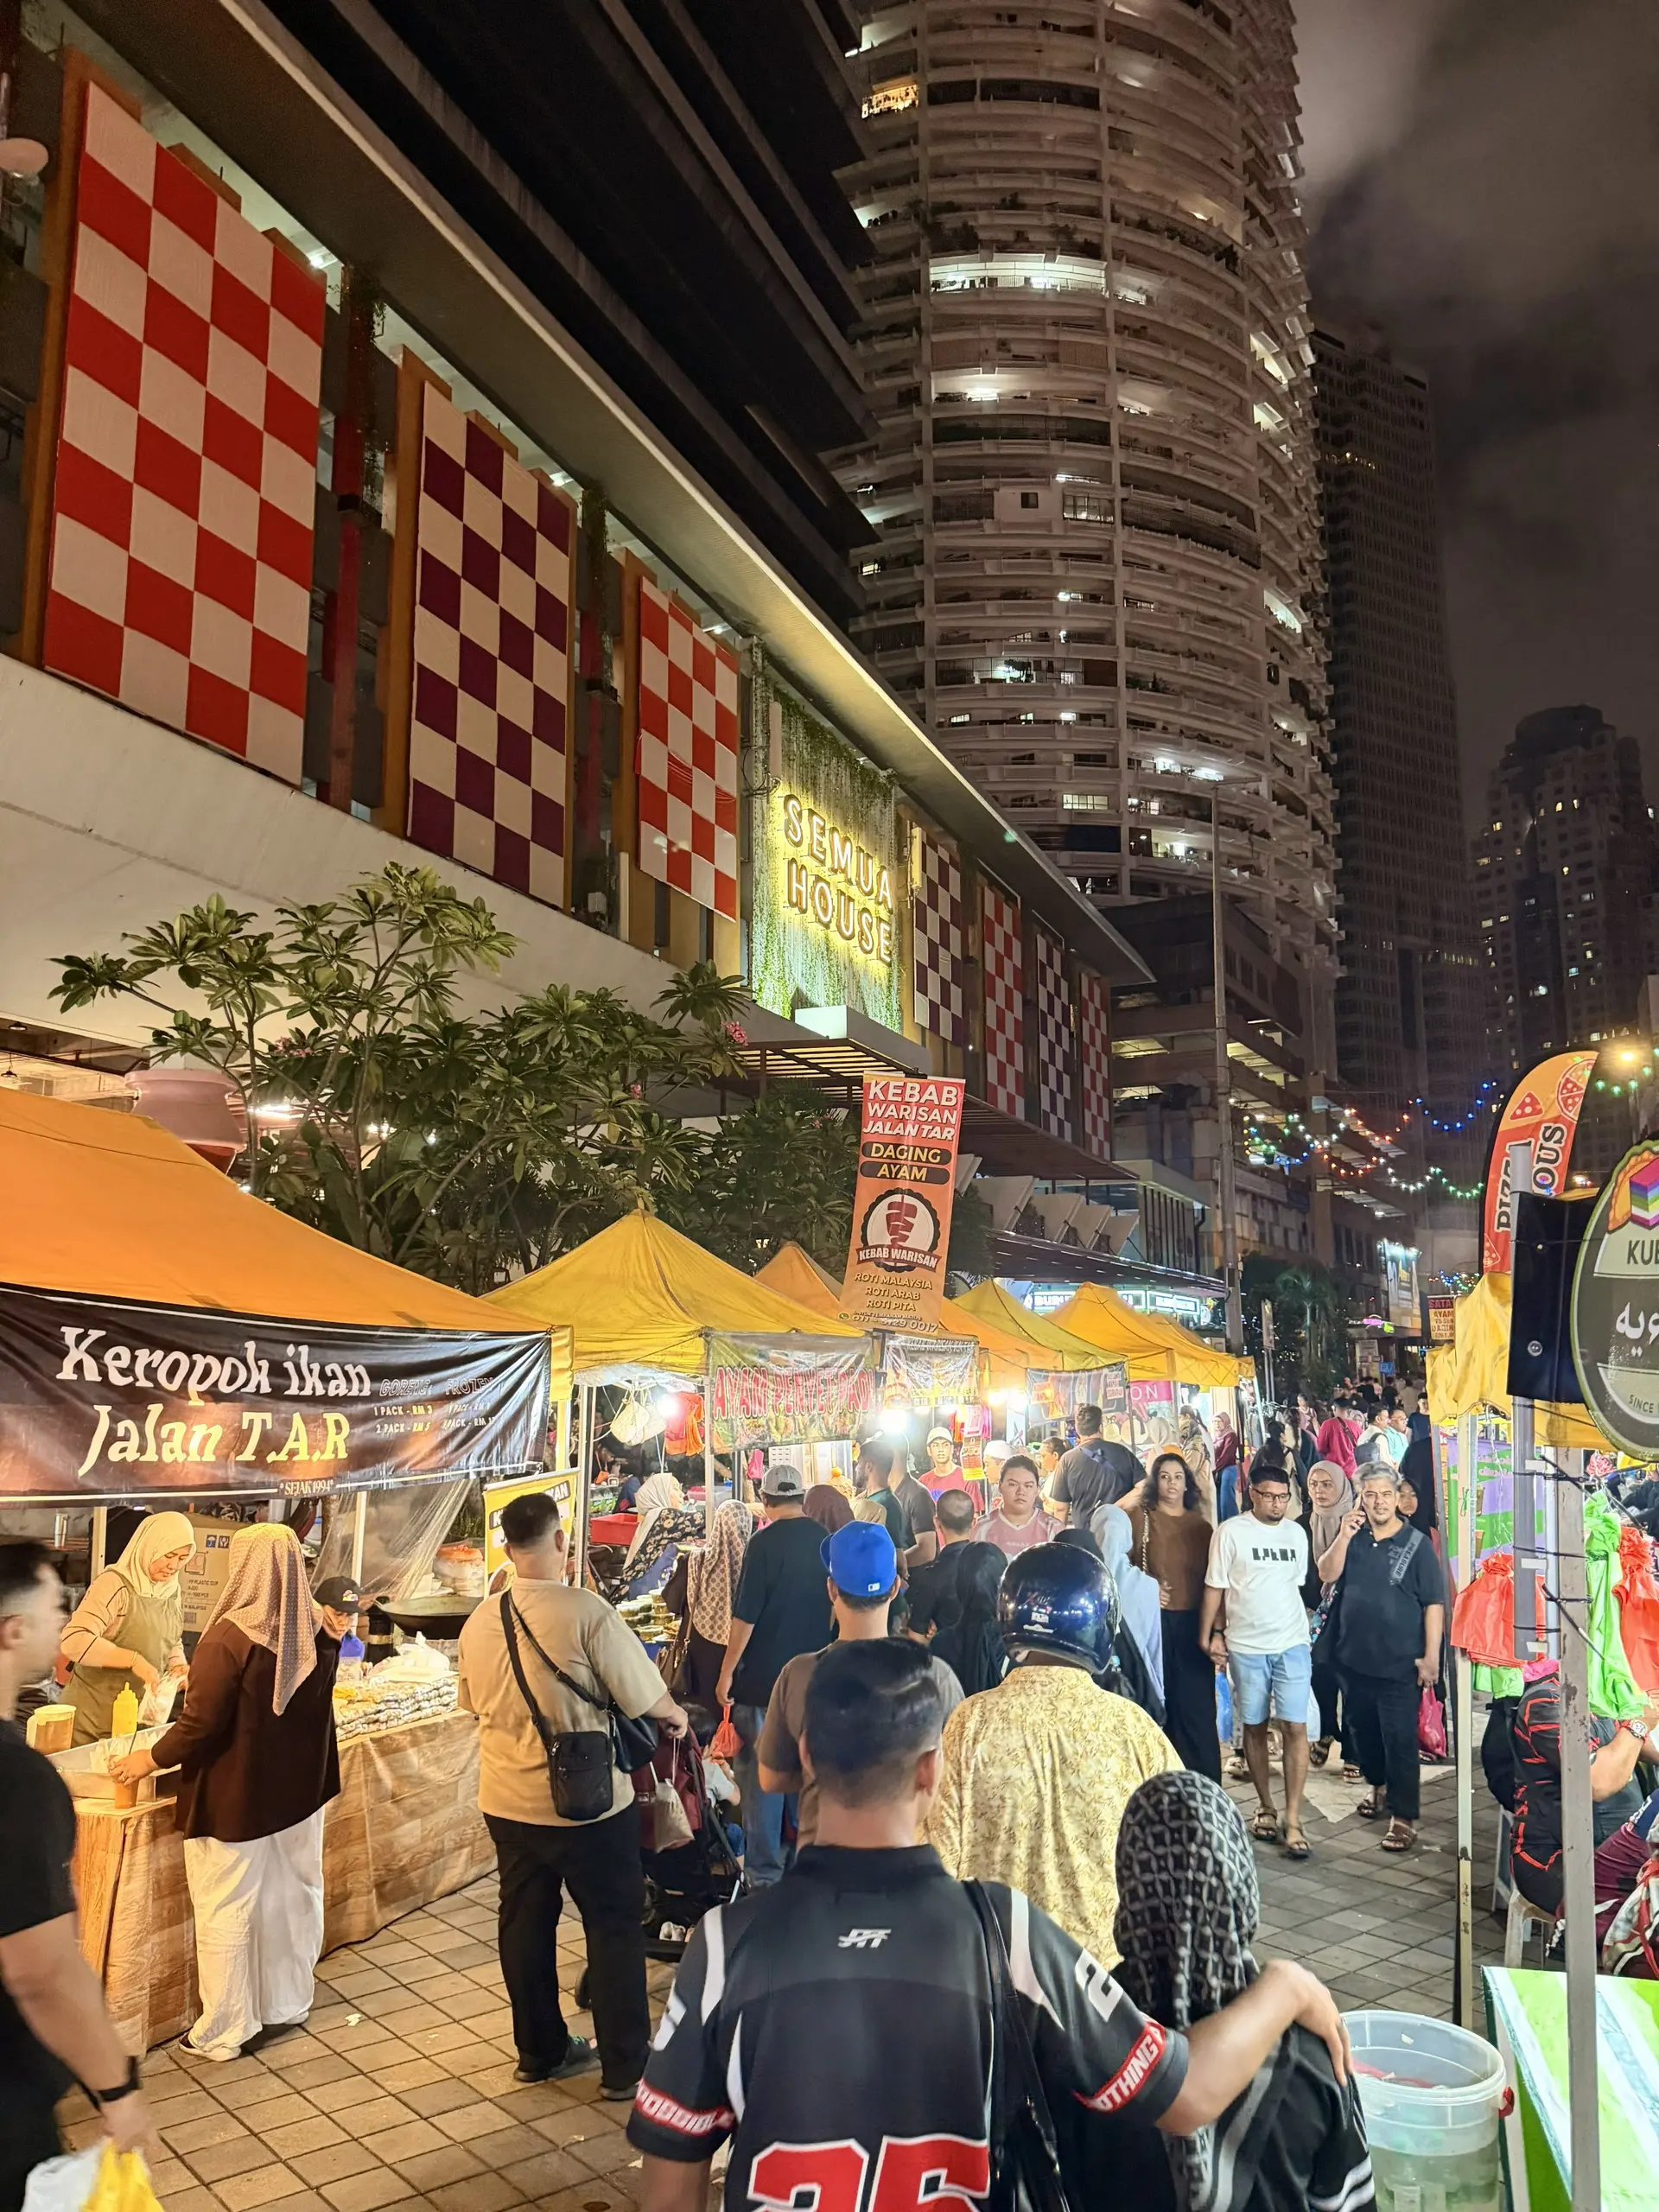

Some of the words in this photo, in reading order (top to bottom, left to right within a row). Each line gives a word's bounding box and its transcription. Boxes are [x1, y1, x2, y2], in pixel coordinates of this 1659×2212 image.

[784, 794, 893, 914] SEMUA
[787, 857, 892, 967] HOUSE
[868, 1080, 958, 1106] KEBAB
[868, 1102, 957, 1124] WARISAN
[862, 1121, 919, 1137] JALAN
[921, 1124, 956, 1141] TAR
[870, 1143, 941, 1163] DAGING
[1532, 1125, 1566, 1196] OUS
[877, 1163, 927, 1181] AYAM
[859, 1247, 889, 1261] KEBAB
[891, 1248, 938, 1268] WARISAN
[855, 1273, 880, 1284] ROTI
[880, 1275, 933, 1290] MALAYSIA
[865, 1286, 890, 1297] ROTI
[891, 1289, 921, 1300] ARAB
[867, 1299, 891, 1309] ROTI
[893, 1302, 916, 1311] PITA
[910, 1322, 938, 1332] 0017
[55, 1325, 272, 1406] Keropok
[283, 1344, 372, 1396] ikan
[713, 1366, 768, 1420] AYAM
[772, 1367, 835, 1417] PENYET
[374, 1406, 378, 1416] 1
[380, 1406, 404, 1415] PACK
[412, 1405, 425, 1415] RM
[427, 1405, 433, 1414] 3
[1629, 1394, 1655, 1413] SINCE
[376, 1423, 381, 1433] 2
[384, 1422, 405, 1433] PACK
[412, 1422, 424, 1432] RM
[424, 1421, 431, 1431] 5
[447, 1418, 466, 1427] PACK
[474, 1416, 486, 1426] RM
[78, 1403, 223, 1477] Jalan
[283, 1480, 311, 1496] SEJAK
[312, 1478, 331, 1494] 1994
